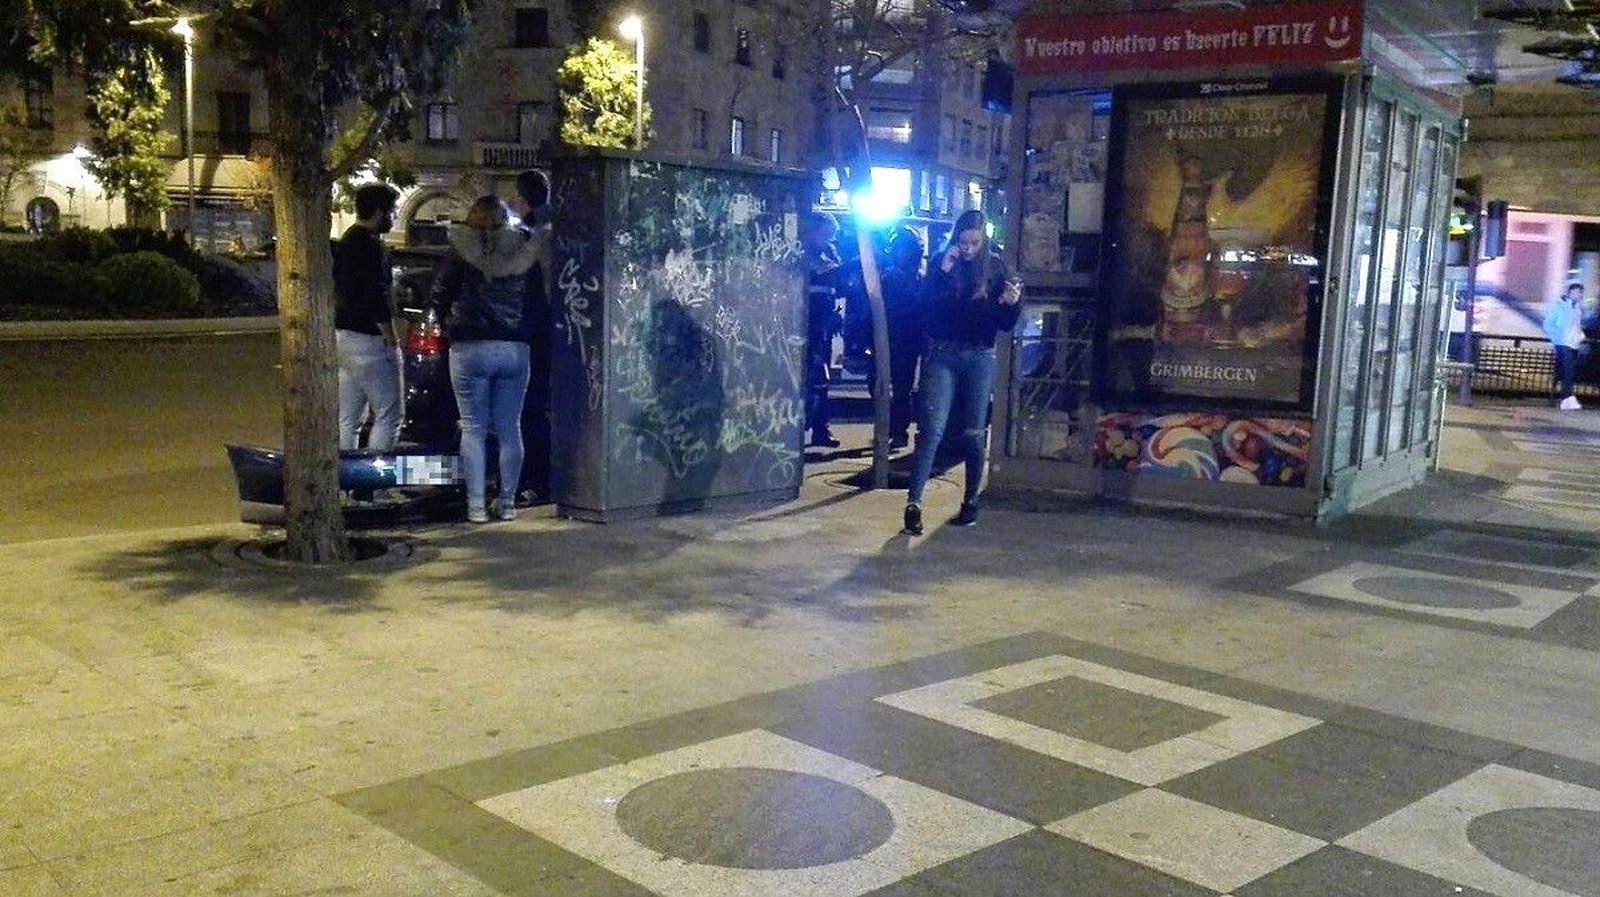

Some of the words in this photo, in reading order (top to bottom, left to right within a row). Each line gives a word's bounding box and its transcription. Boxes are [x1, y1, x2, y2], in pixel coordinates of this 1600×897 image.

[1024, 37, 1086, 57] Nuestro
[1163, 35, 1181, 51] es
[1252, 22, 1315, 47] FELIZ
[1150, 362, 1257, 382] GRIMBERGEN
